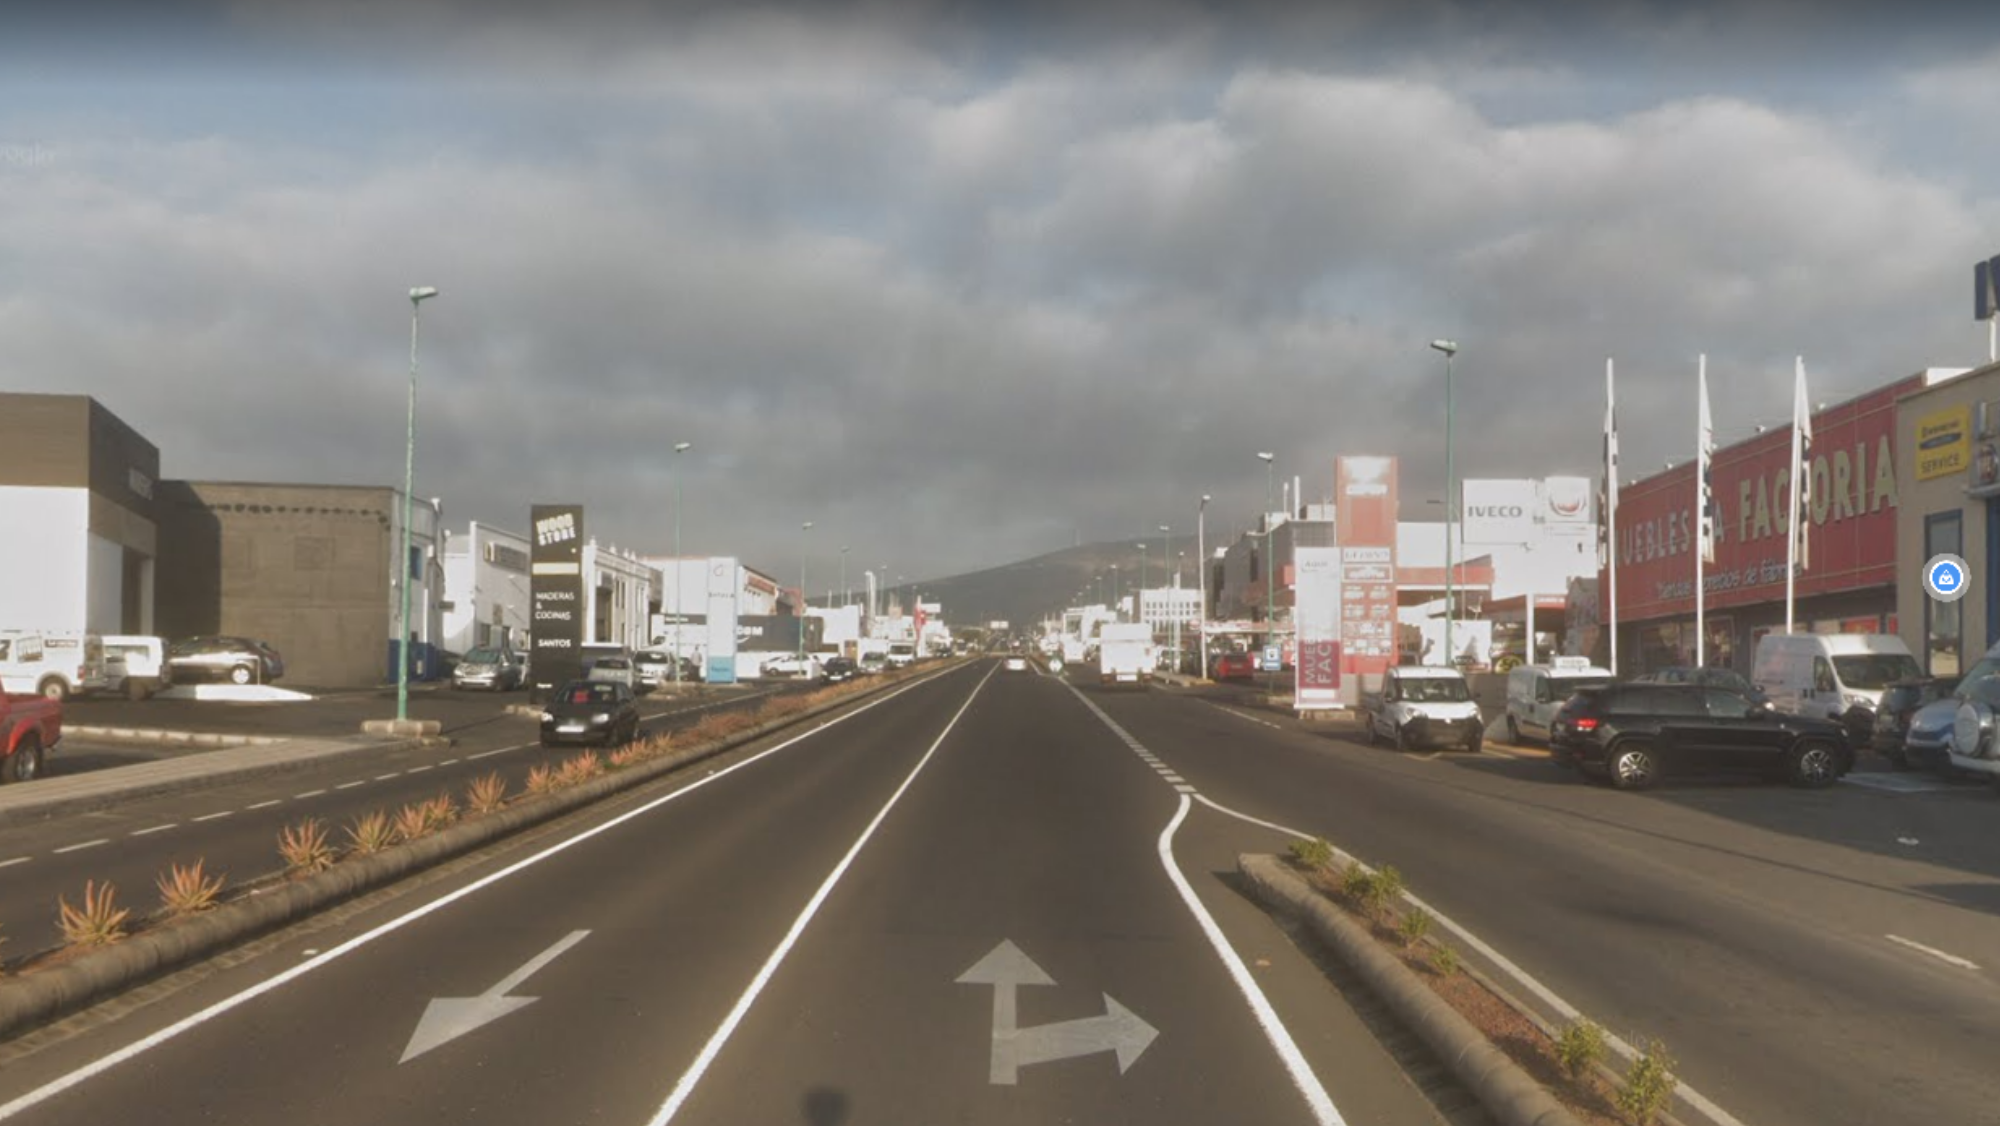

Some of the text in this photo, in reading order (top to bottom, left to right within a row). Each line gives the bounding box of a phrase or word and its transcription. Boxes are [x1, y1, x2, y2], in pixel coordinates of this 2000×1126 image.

[1616, 509, 1690, 569] UEBLES
[1738, 433, 1899, 544] FACORIA
[1467, 505, 1523, 518] IVECO
[536, 591, 575, 602] MADERAS
[535, 611, 571, 621] COCINAS
[538, 638, 572, 648] SANTOS
